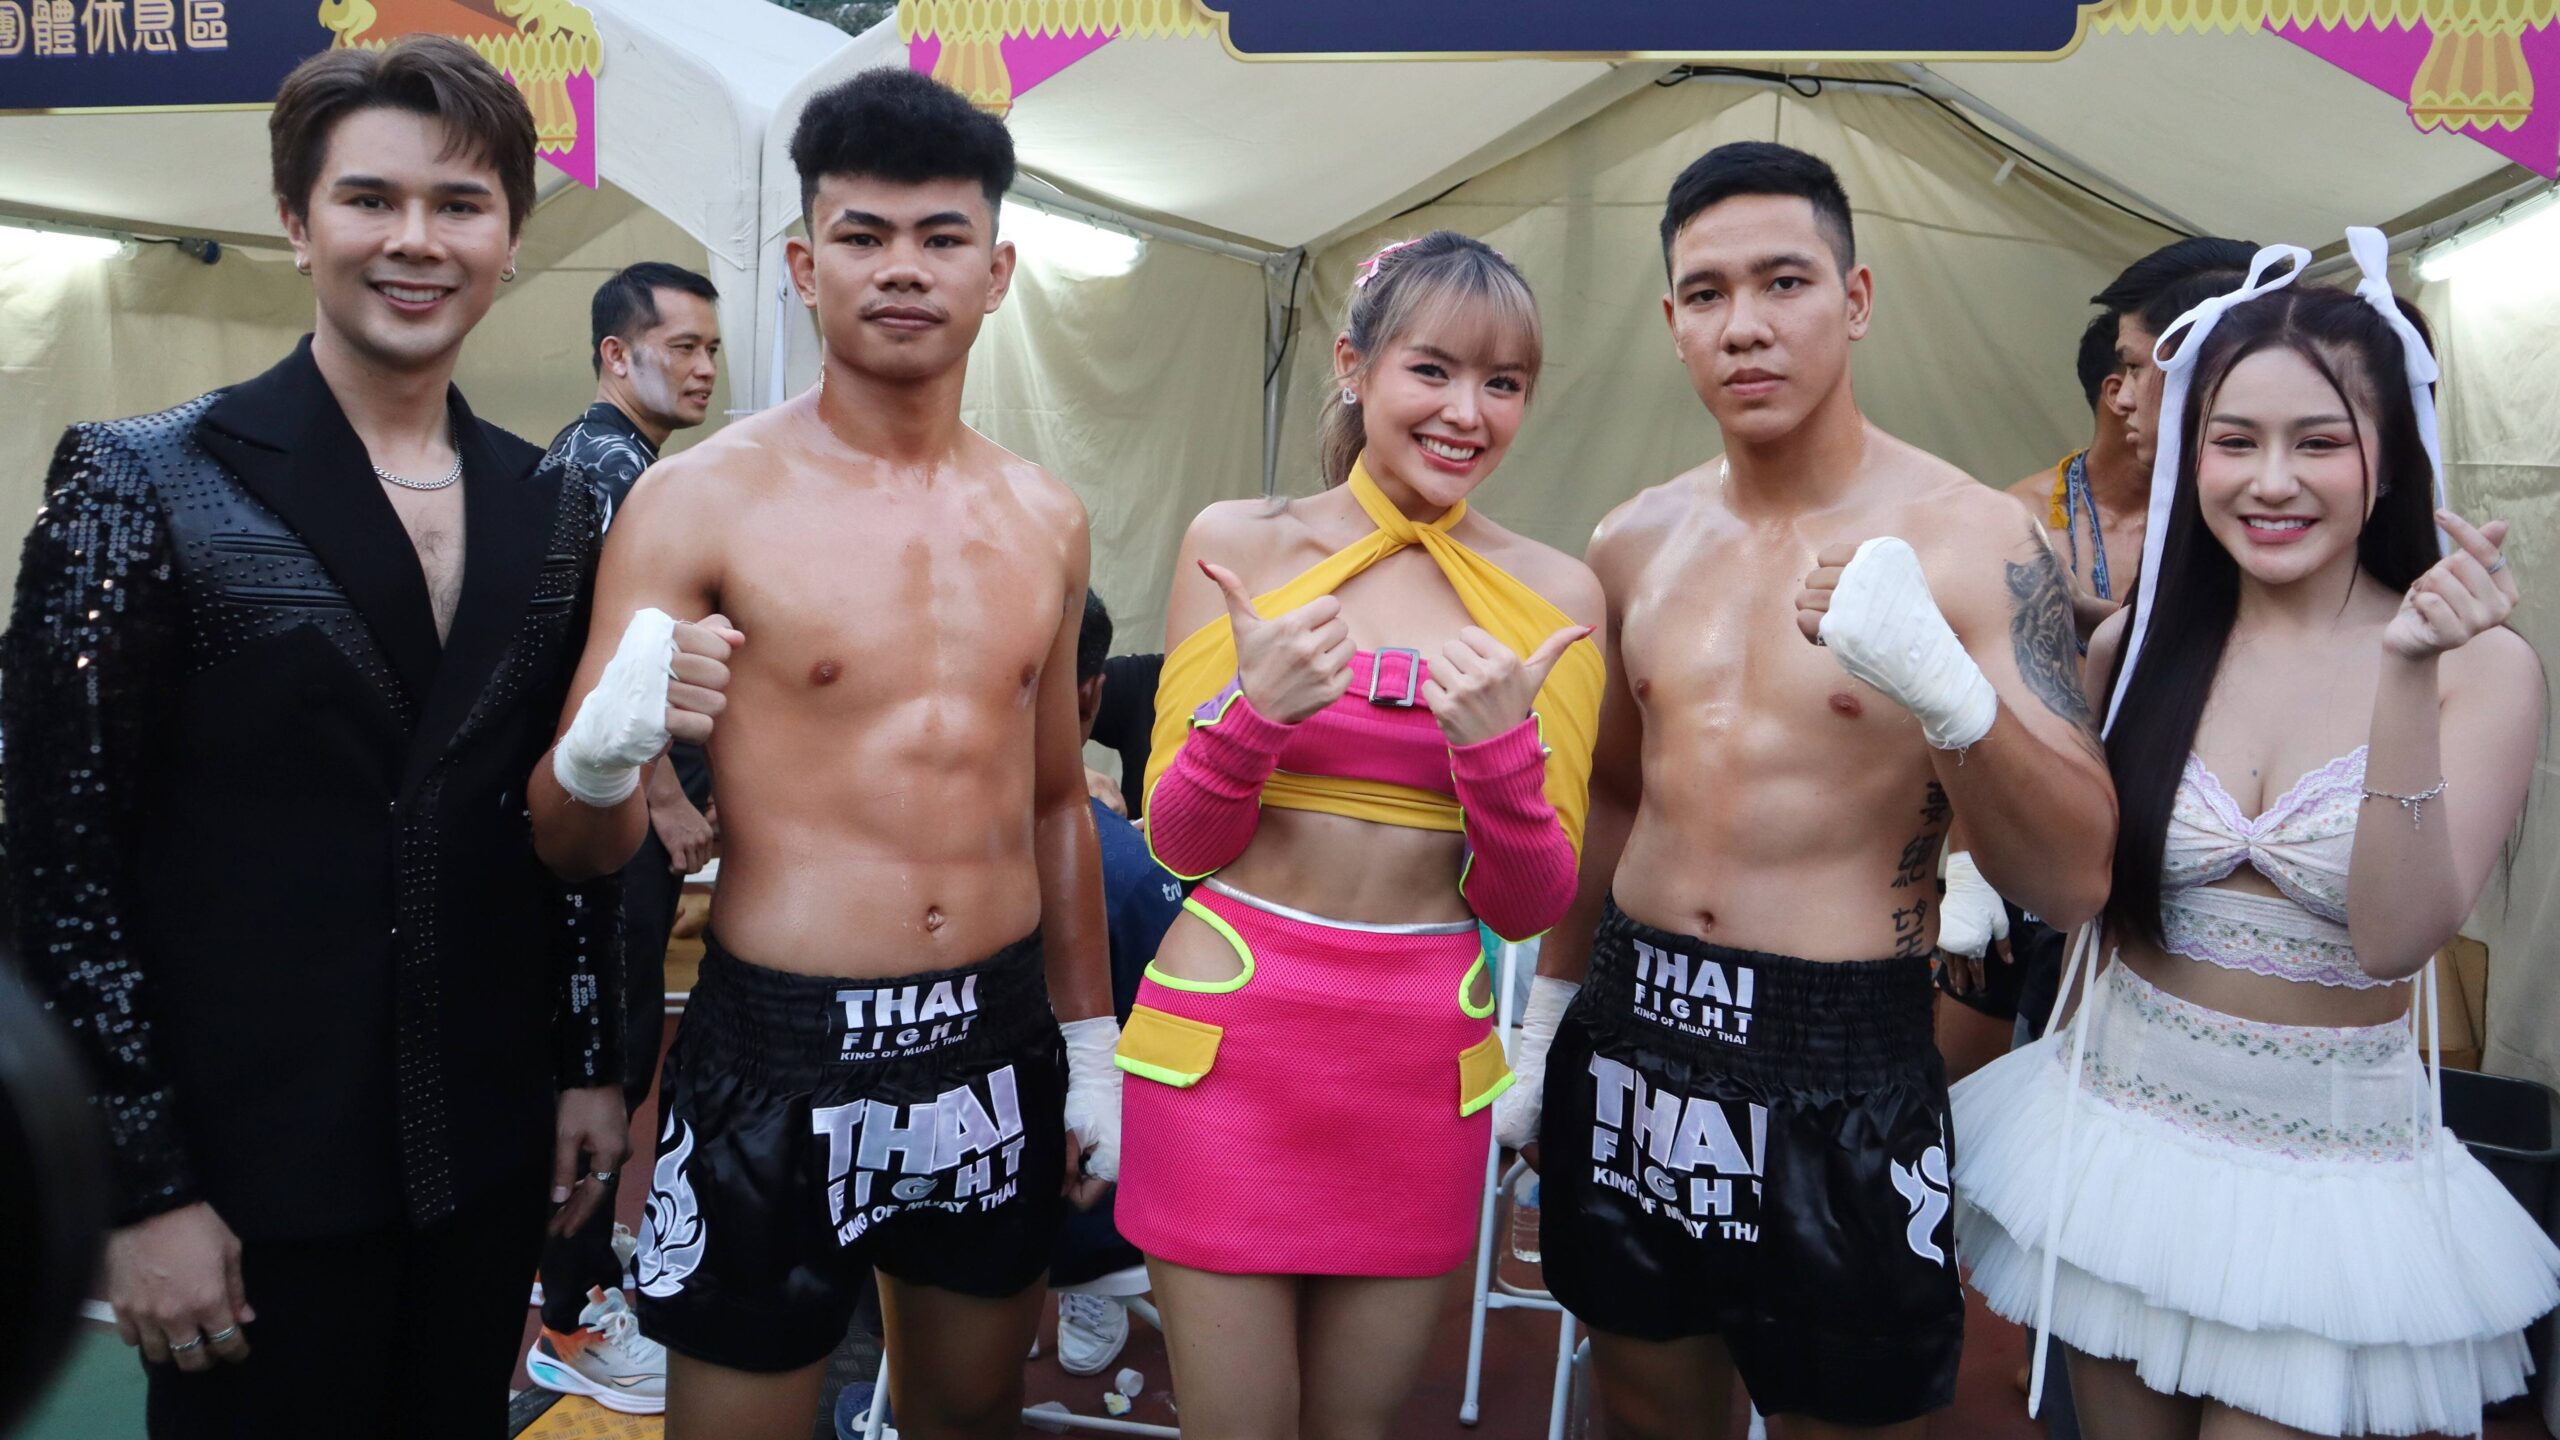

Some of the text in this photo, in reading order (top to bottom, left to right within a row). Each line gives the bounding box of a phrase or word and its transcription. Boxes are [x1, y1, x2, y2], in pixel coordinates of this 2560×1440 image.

[836, 973, 979, 1029] THAI
[1633, 938, 1755, 1009] THAI
[841, 1014, 979, 1050] FIGHT
[1633, 1005, 1748, 1045] KING OF MUAY THAI
[1634, 982, 1753, 1034] FIGHT
[840, 1032, 968, 1061] KING OF MUAY THAI
[812, 1064, 1024, 1182] THAI
[1588, 1050, 1769, 1178] THAI
[827, 1135, 1026, 1227] FIGHT
[1592, 1166, 1638, 1199] KING
[837, 1212, 869, 1247] KING
[871, 1204, 901, 1223] OF
[979, 1178, 1018, 1212] THAI
